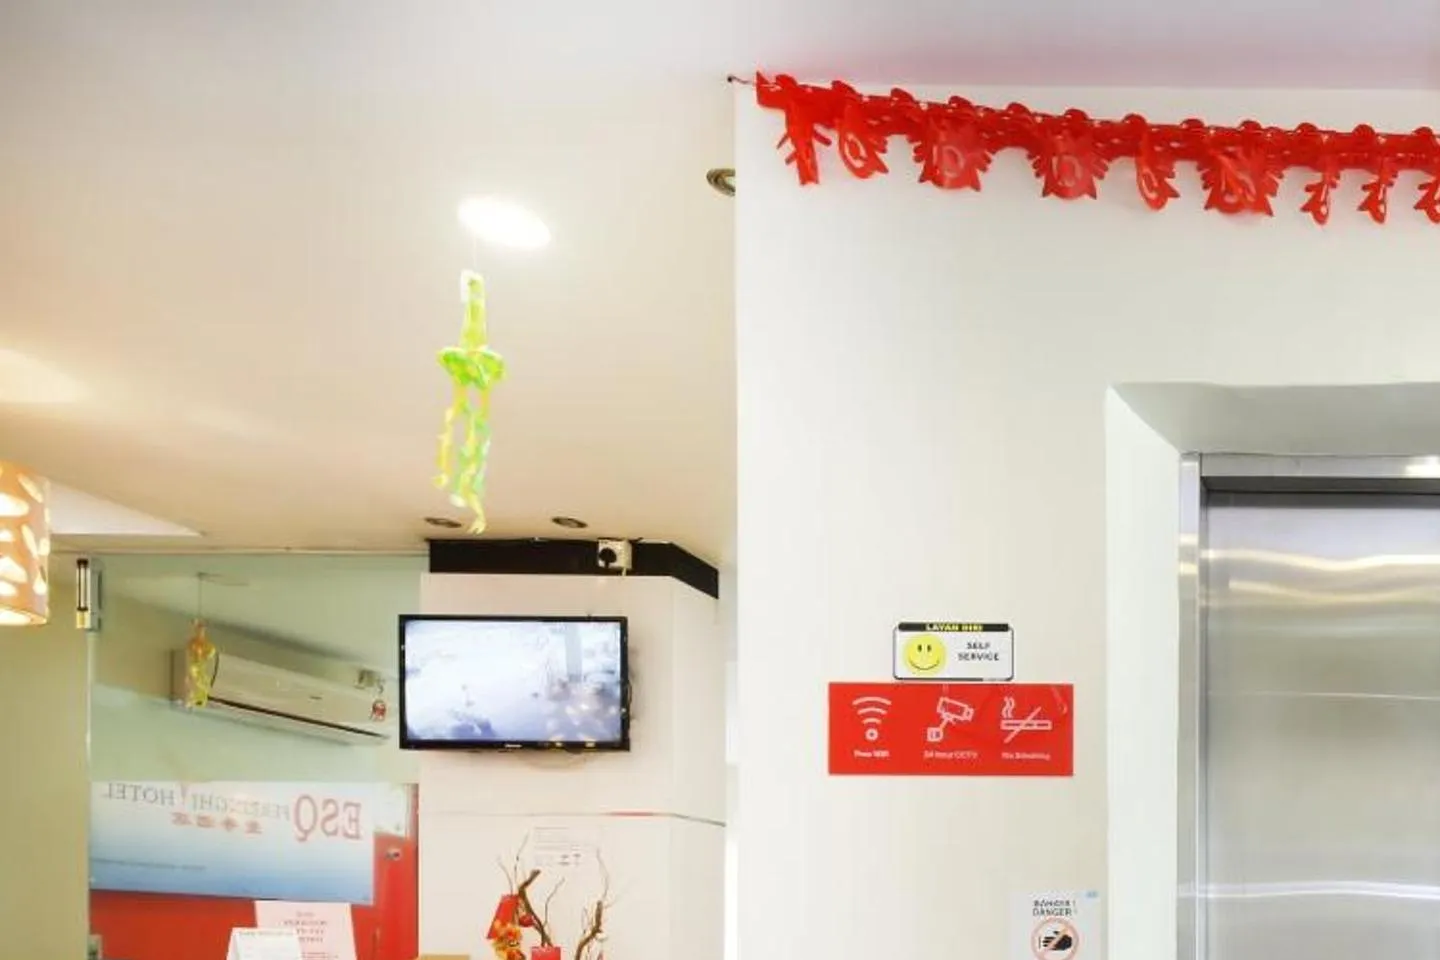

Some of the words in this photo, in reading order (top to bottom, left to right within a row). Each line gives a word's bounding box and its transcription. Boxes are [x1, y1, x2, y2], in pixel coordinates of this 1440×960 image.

[925, 623, 960, 632] LAYAN
[966, 641, 991, 650] SELF
[957, 652, 1000, 661] SERVICE
[953, 750, 979, 759] CCTV
[1032, 907, 1072, 917] DANGER
